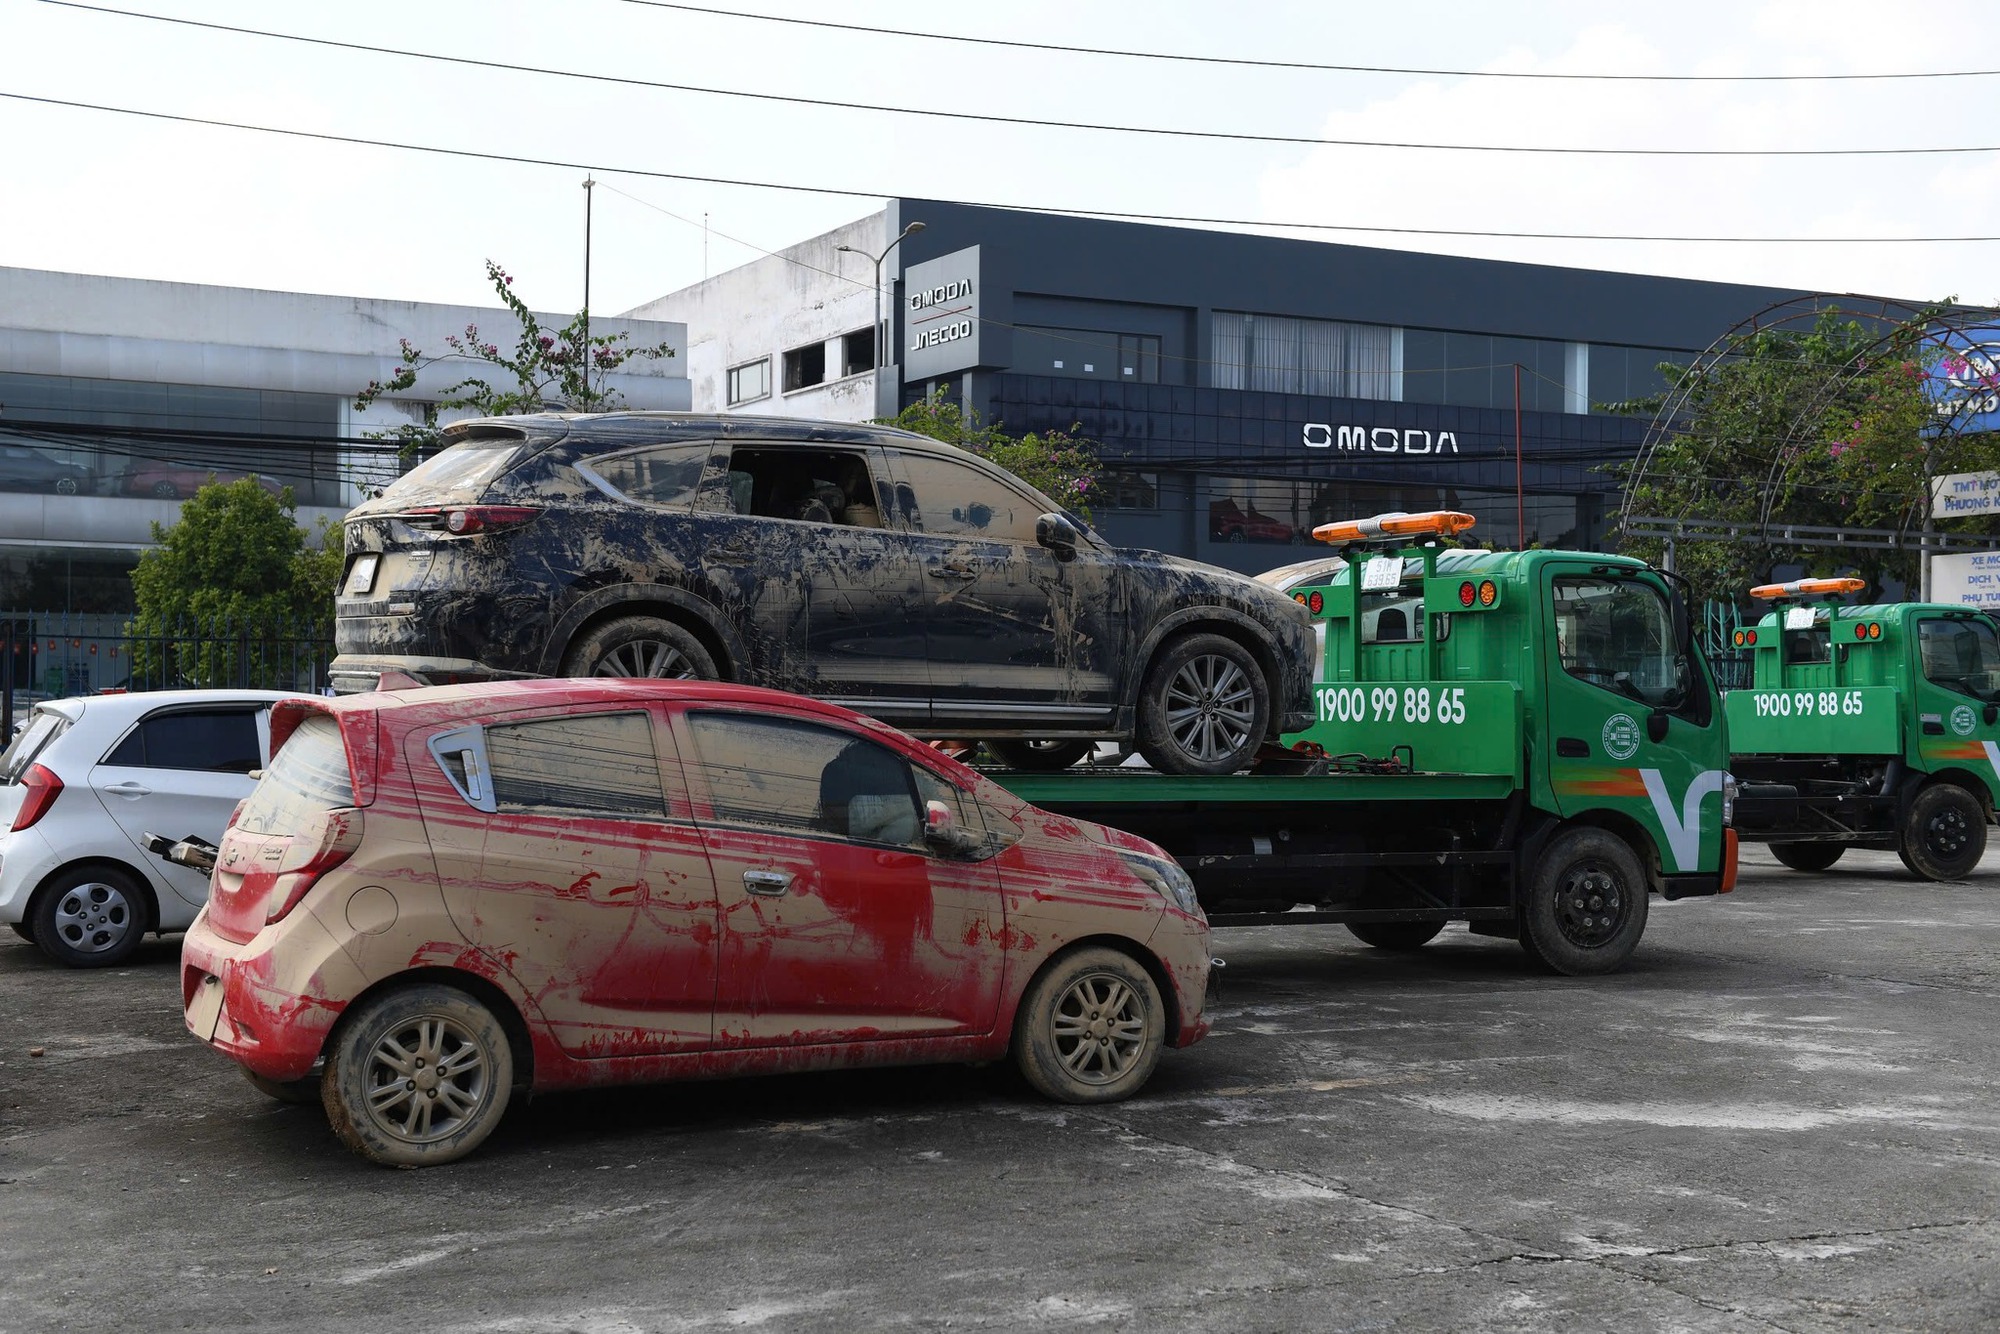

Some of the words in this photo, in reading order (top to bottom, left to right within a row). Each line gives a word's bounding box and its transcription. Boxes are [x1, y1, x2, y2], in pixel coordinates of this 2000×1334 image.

[911, 279, 972, 311] OMODA
[911, 320, 971, 351] JAECOO
[1303, 423, 1459, 453] OMODA
[1972, 556, 1984, 565] XE
[1316, 687, 1365, 722] 1900
[1371, 687, 1397, 722] 99
[1404, 687, 1430, 723] 88
[1437, 688, 1465, 724] 65
[1754, 693, 1790, 716] 1900
[1795, 692, 1814, 716] 99
[1818, 692, 1838, 716] 88
[1842, 691, 1862, 715] 65
